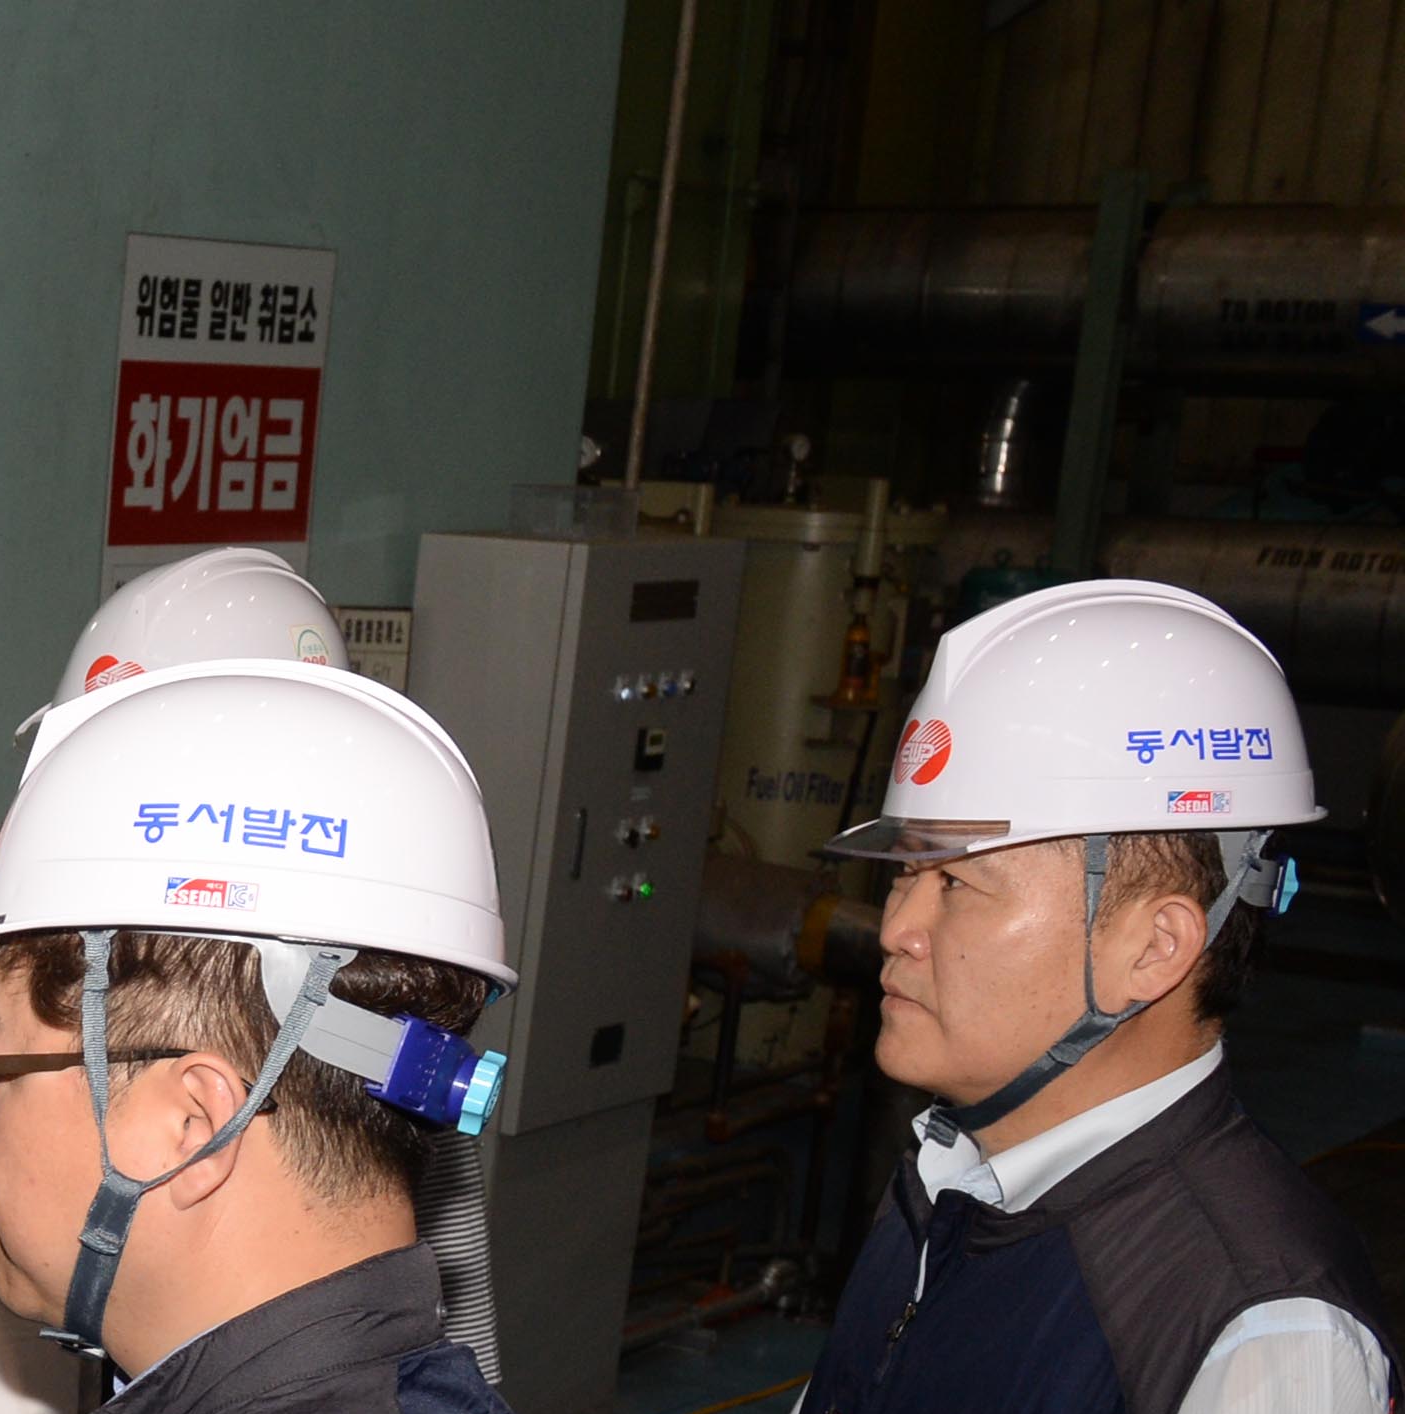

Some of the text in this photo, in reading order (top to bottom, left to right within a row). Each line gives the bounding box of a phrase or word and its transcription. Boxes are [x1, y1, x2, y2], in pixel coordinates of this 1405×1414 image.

[135, 274, 318, 345] 위험물 일반 취급소
[122, 392, 305, 513] 화기엄금
[1126, 726, 1274, 766] 동서발전
[132, 801, 349, 859] 동서발전
